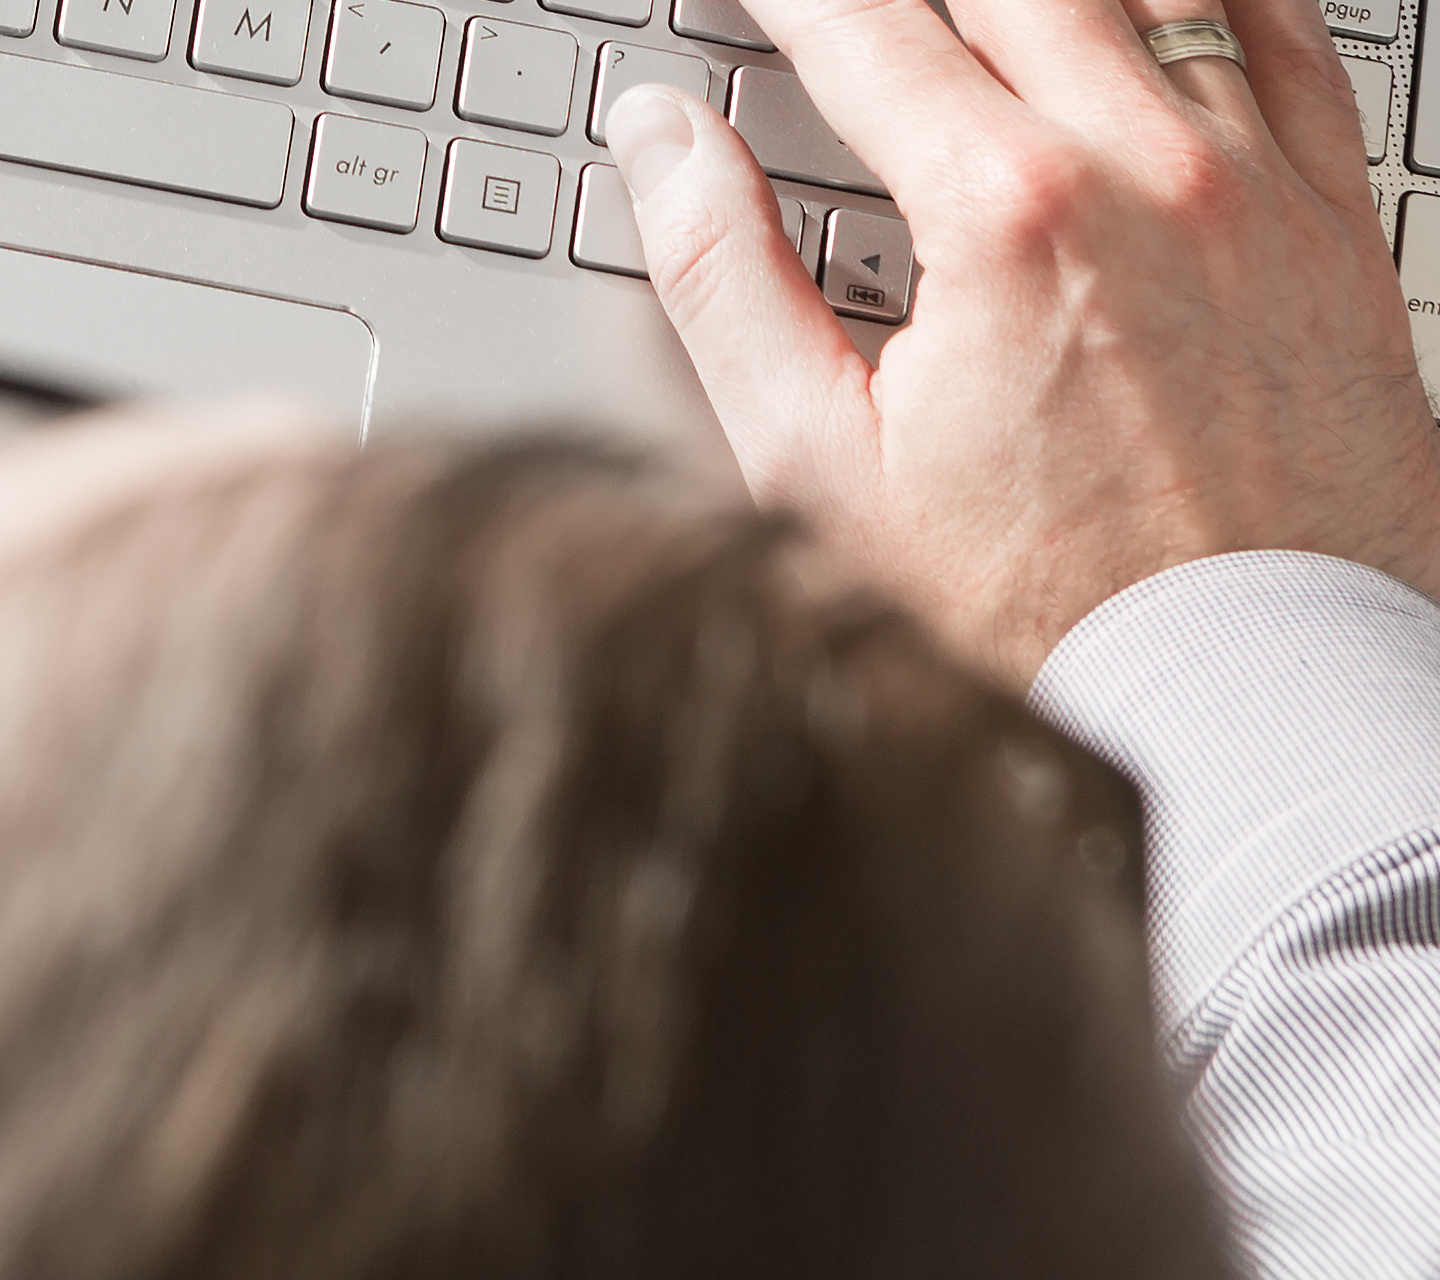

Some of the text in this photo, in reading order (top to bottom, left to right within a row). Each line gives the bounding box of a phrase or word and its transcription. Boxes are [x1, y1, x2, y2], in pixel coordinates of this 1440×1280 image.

[234, 8, 271, 41] M
[1325, 2, 1370, 23] pgup
[337, 156, 399, 185] alt gr
